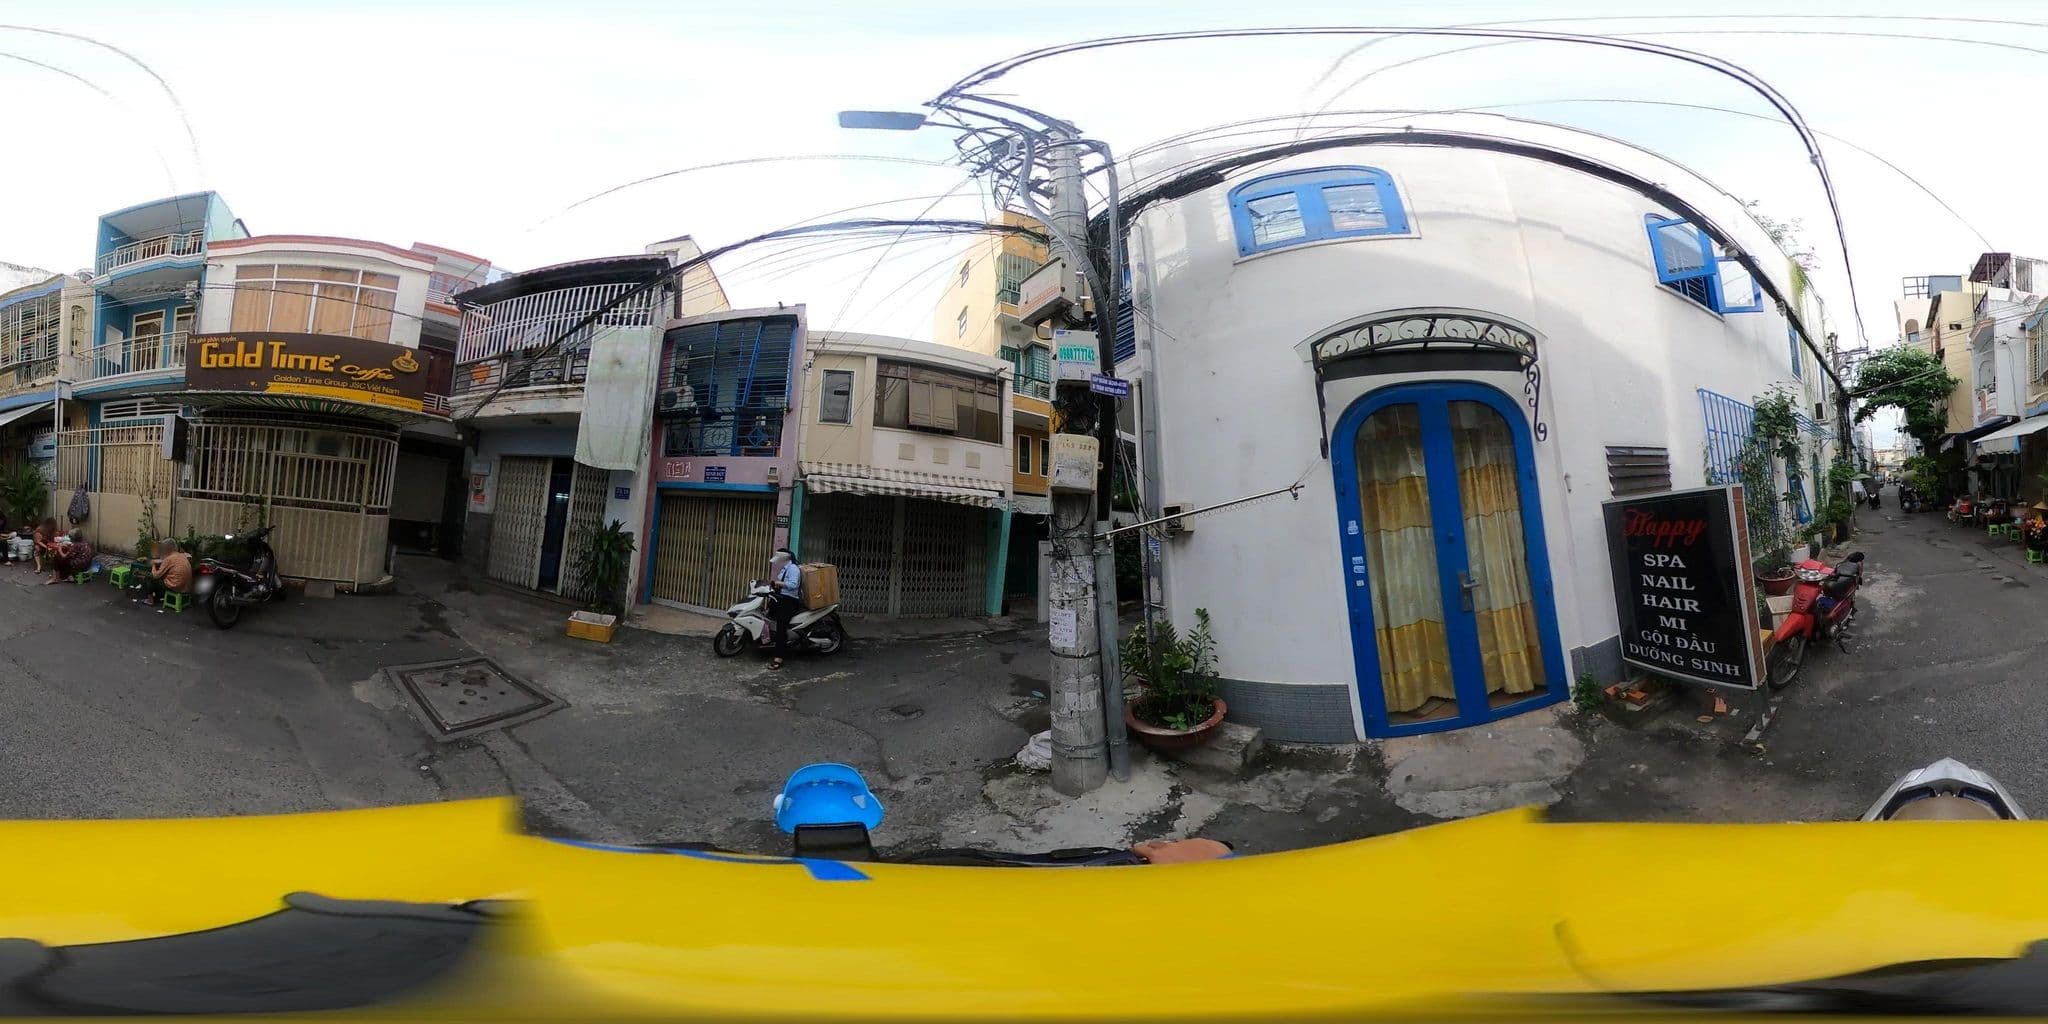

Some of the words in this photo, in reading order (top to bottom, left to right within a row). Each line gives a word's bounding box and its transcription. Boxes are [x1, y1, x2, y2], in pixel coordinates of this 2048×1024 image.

[200, 341, 265, 369] Gold
[340, 364, 395, 381] Coffee
[273, 374, 301, 384] Golden
[304, 376, 323, 385] Time
[324, 378, 349, 388] Group
[349, 380, 367, 389] JSC
[382, 386, 400, 396] Nam
[1623, 508, 1708, 548] Happy
[1643, 553, 1686, 569] SPA
[1641, 574, 1696, 591] NAIL
[1642, 594, 1701, 613] HAIR
[1659, 615, 1688, 631] MI
[1641, 629, 1671, 646] GỘI
[1676, 633, 1716, 654] ĐẦU
[1629, 643, 1685, 666] DƯỠNG
[1691, 658, 1741, 677] SINH
